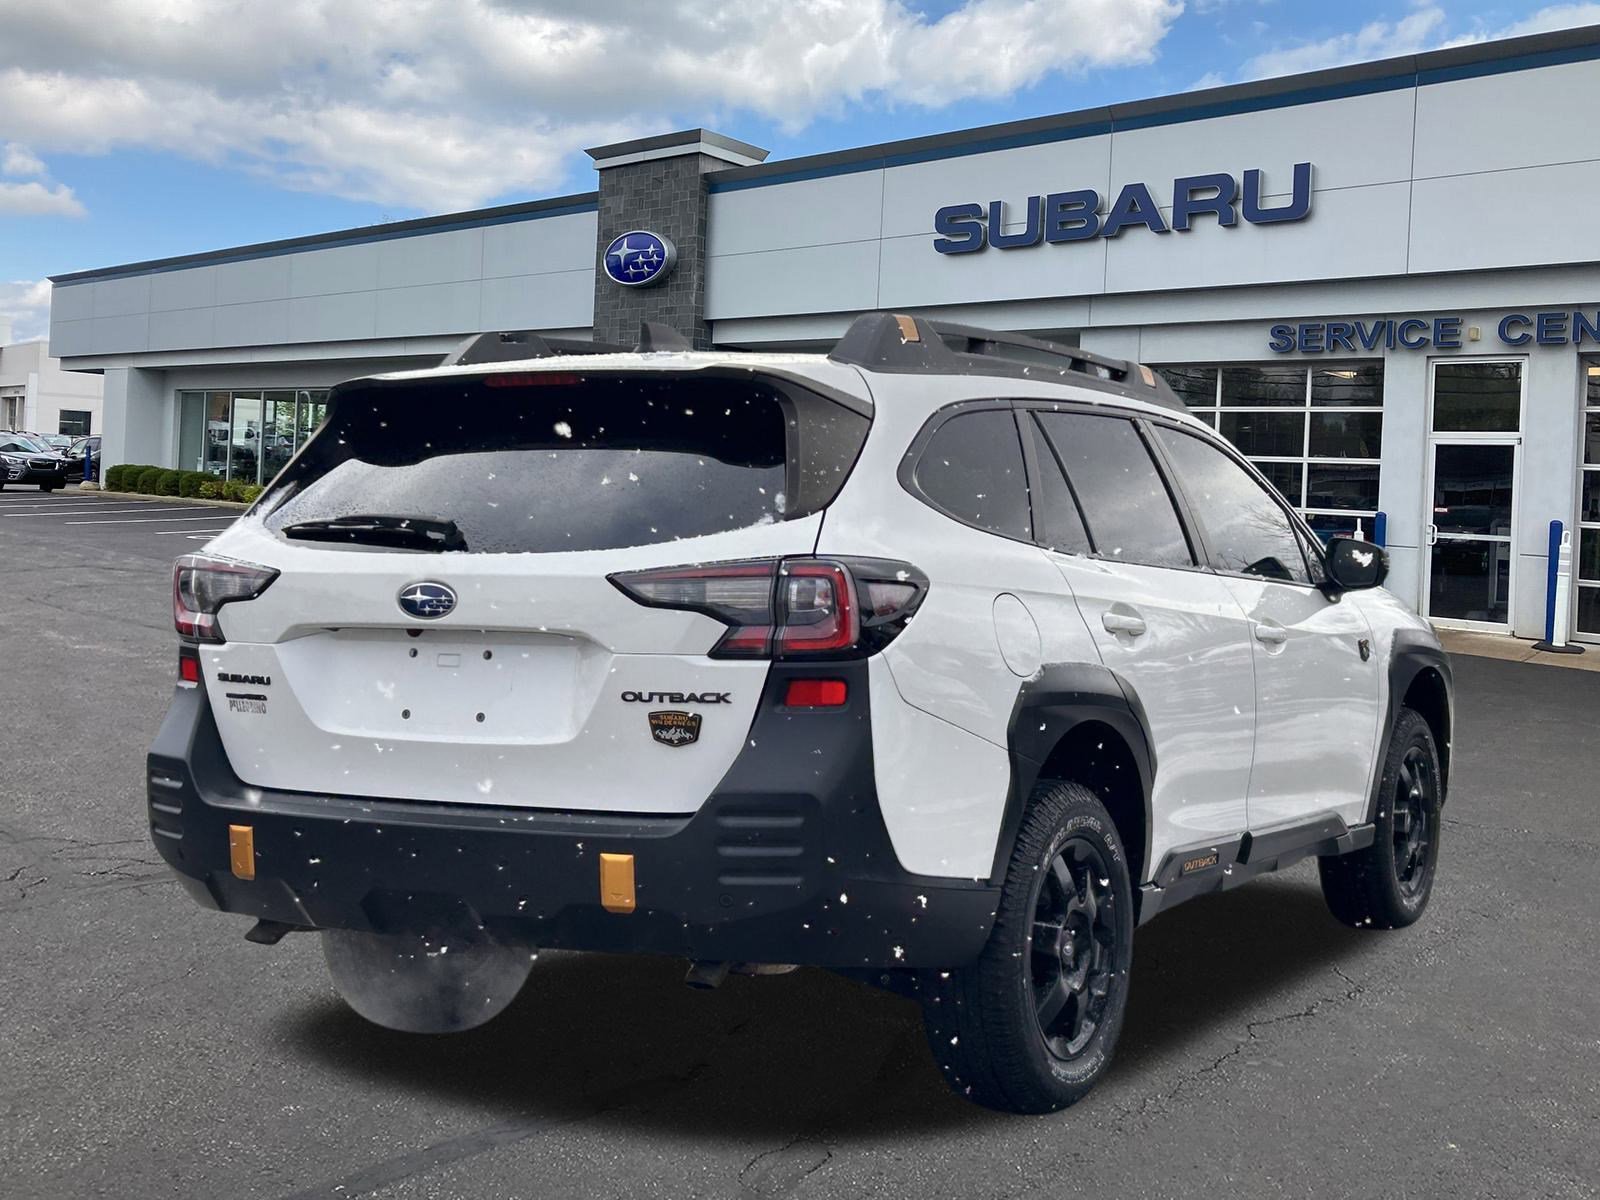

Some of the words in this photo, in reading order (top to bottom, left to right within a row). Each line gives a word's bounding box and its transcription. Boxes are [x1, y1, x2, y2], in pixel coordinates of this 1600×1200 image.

[934, 161, 1313, 256] SUBARU
[1269, 317, 1464, 353] SERVICE
[1497, 310, 1600, 347] CEN
[218, 673, 271, 685] SUBARU
[621, 690, 732, 704] OUTBACK
[1184, 854, 1217, 872] OUTBACK
